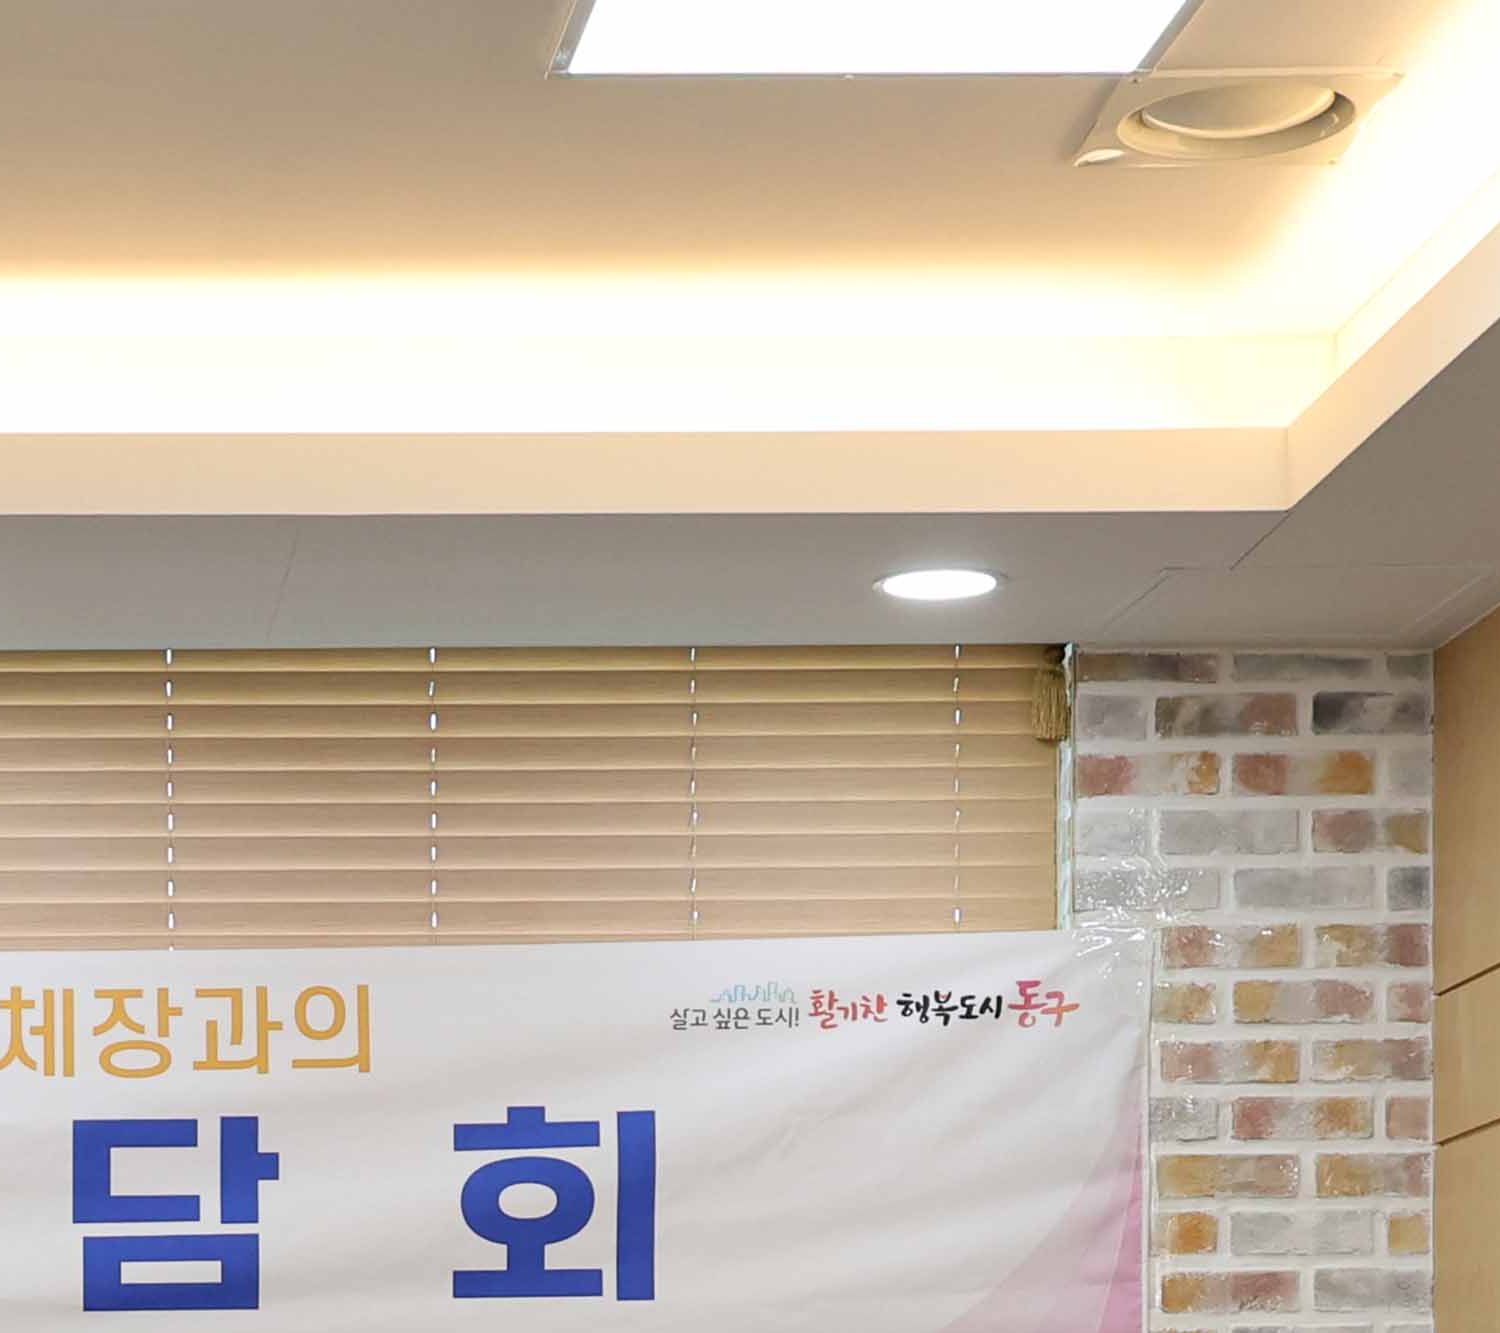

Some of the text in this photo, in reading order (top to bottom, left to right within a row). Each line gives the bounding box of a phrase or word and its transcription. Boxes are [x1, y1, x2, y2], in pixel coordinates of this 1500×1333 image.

[669, 980, 1081, 1031] 살고 싶은 도시! 활기찬 행복도시 동구
